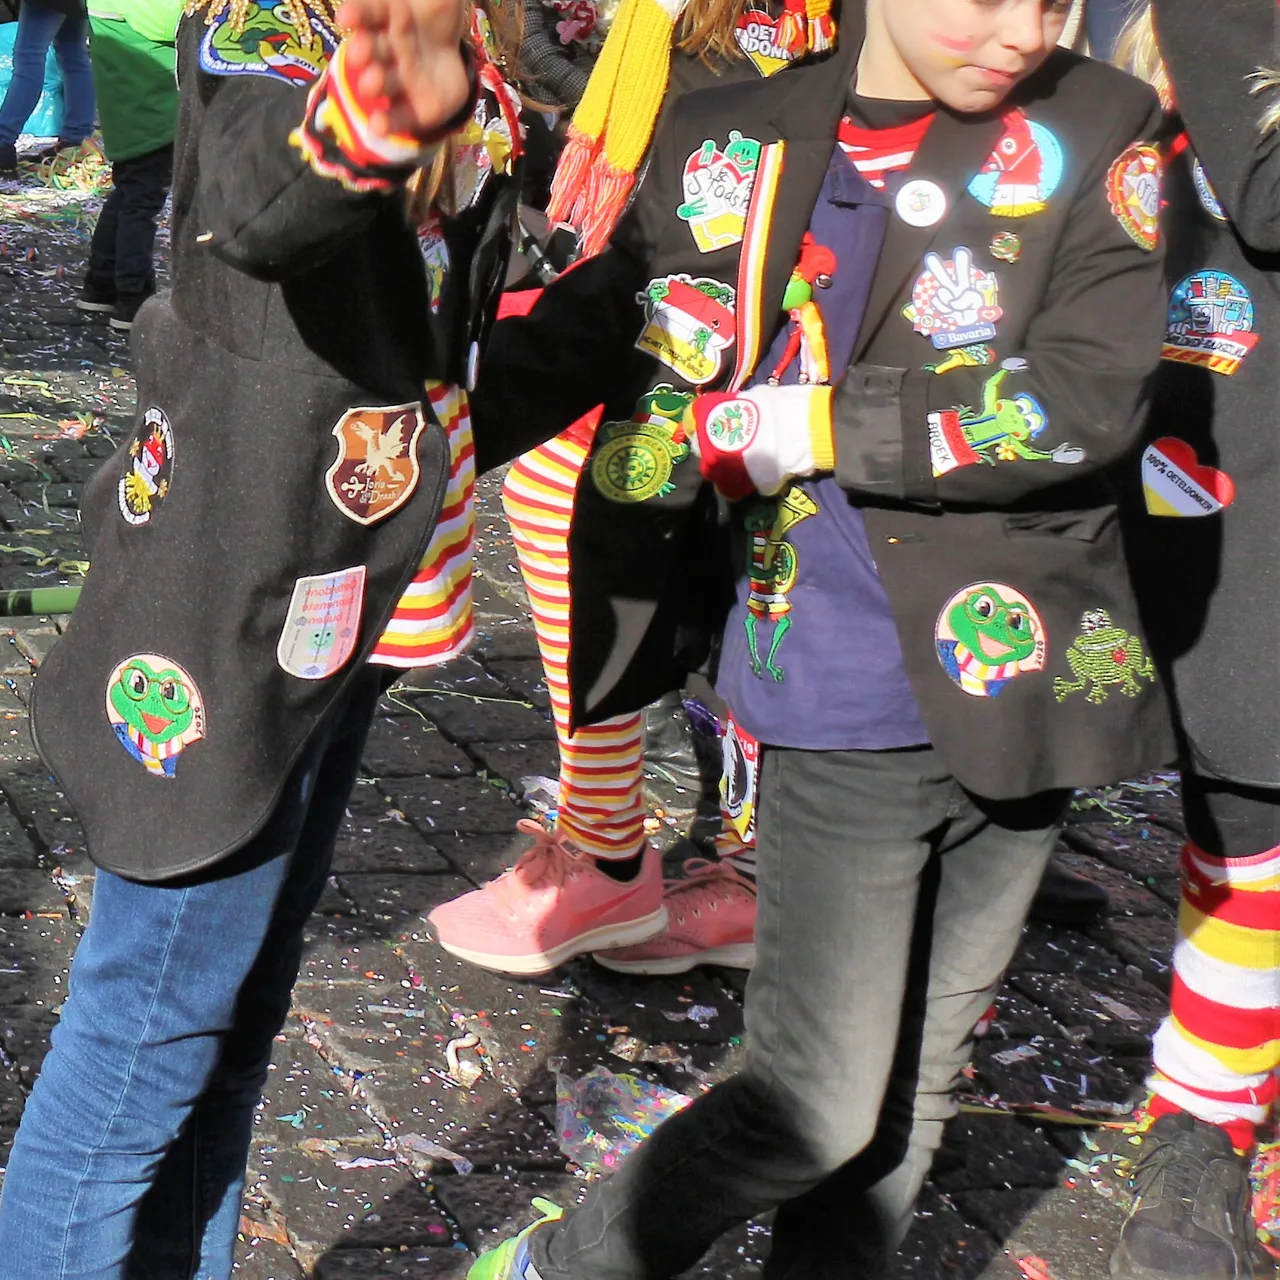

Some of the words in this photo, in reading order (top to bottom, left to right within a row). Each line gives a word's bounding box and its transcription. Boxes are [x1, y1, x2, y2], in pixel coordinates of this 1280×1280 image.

[291, 57, 317, 71] 2011
[948, 326, 992, 343] Bavaria
[927, 421, 952, 465] BROEK
[964, 426, 976, 442] HET
[359, 477, 386, 494] Joris
[1146, 453, 1168, 474] 100%
[1166, 470, 1213, 512] OETELDONKER
[1033, 640, 1044, 666] 2020
[194, 706, 204, 736] 2020
